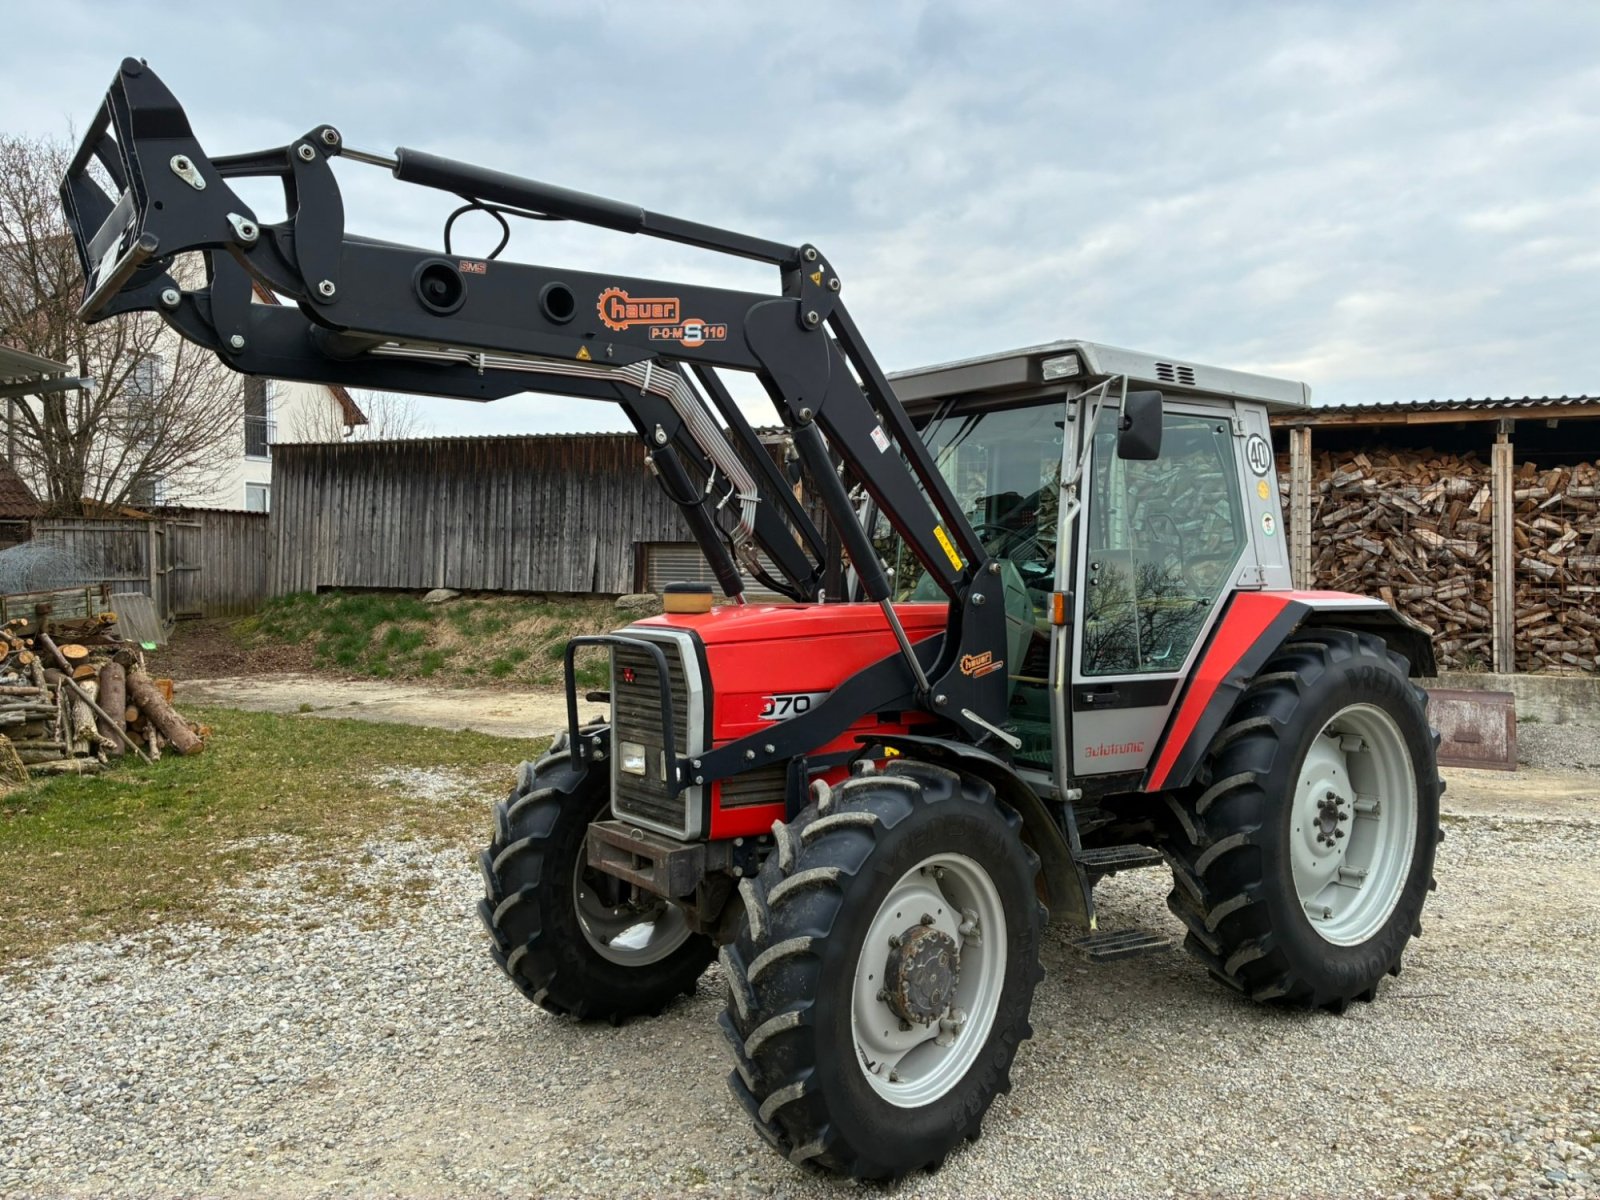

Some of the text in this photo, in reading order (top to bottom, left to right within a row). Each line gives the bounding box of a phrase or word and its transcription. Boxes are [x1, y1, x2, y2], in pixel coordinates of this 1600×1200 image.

[461, 261, 485, 273] SMS
[683, 324, 702, 342] S
[703, 326, 725, 339] 110
[1251, 441, 1267, 469] 40
